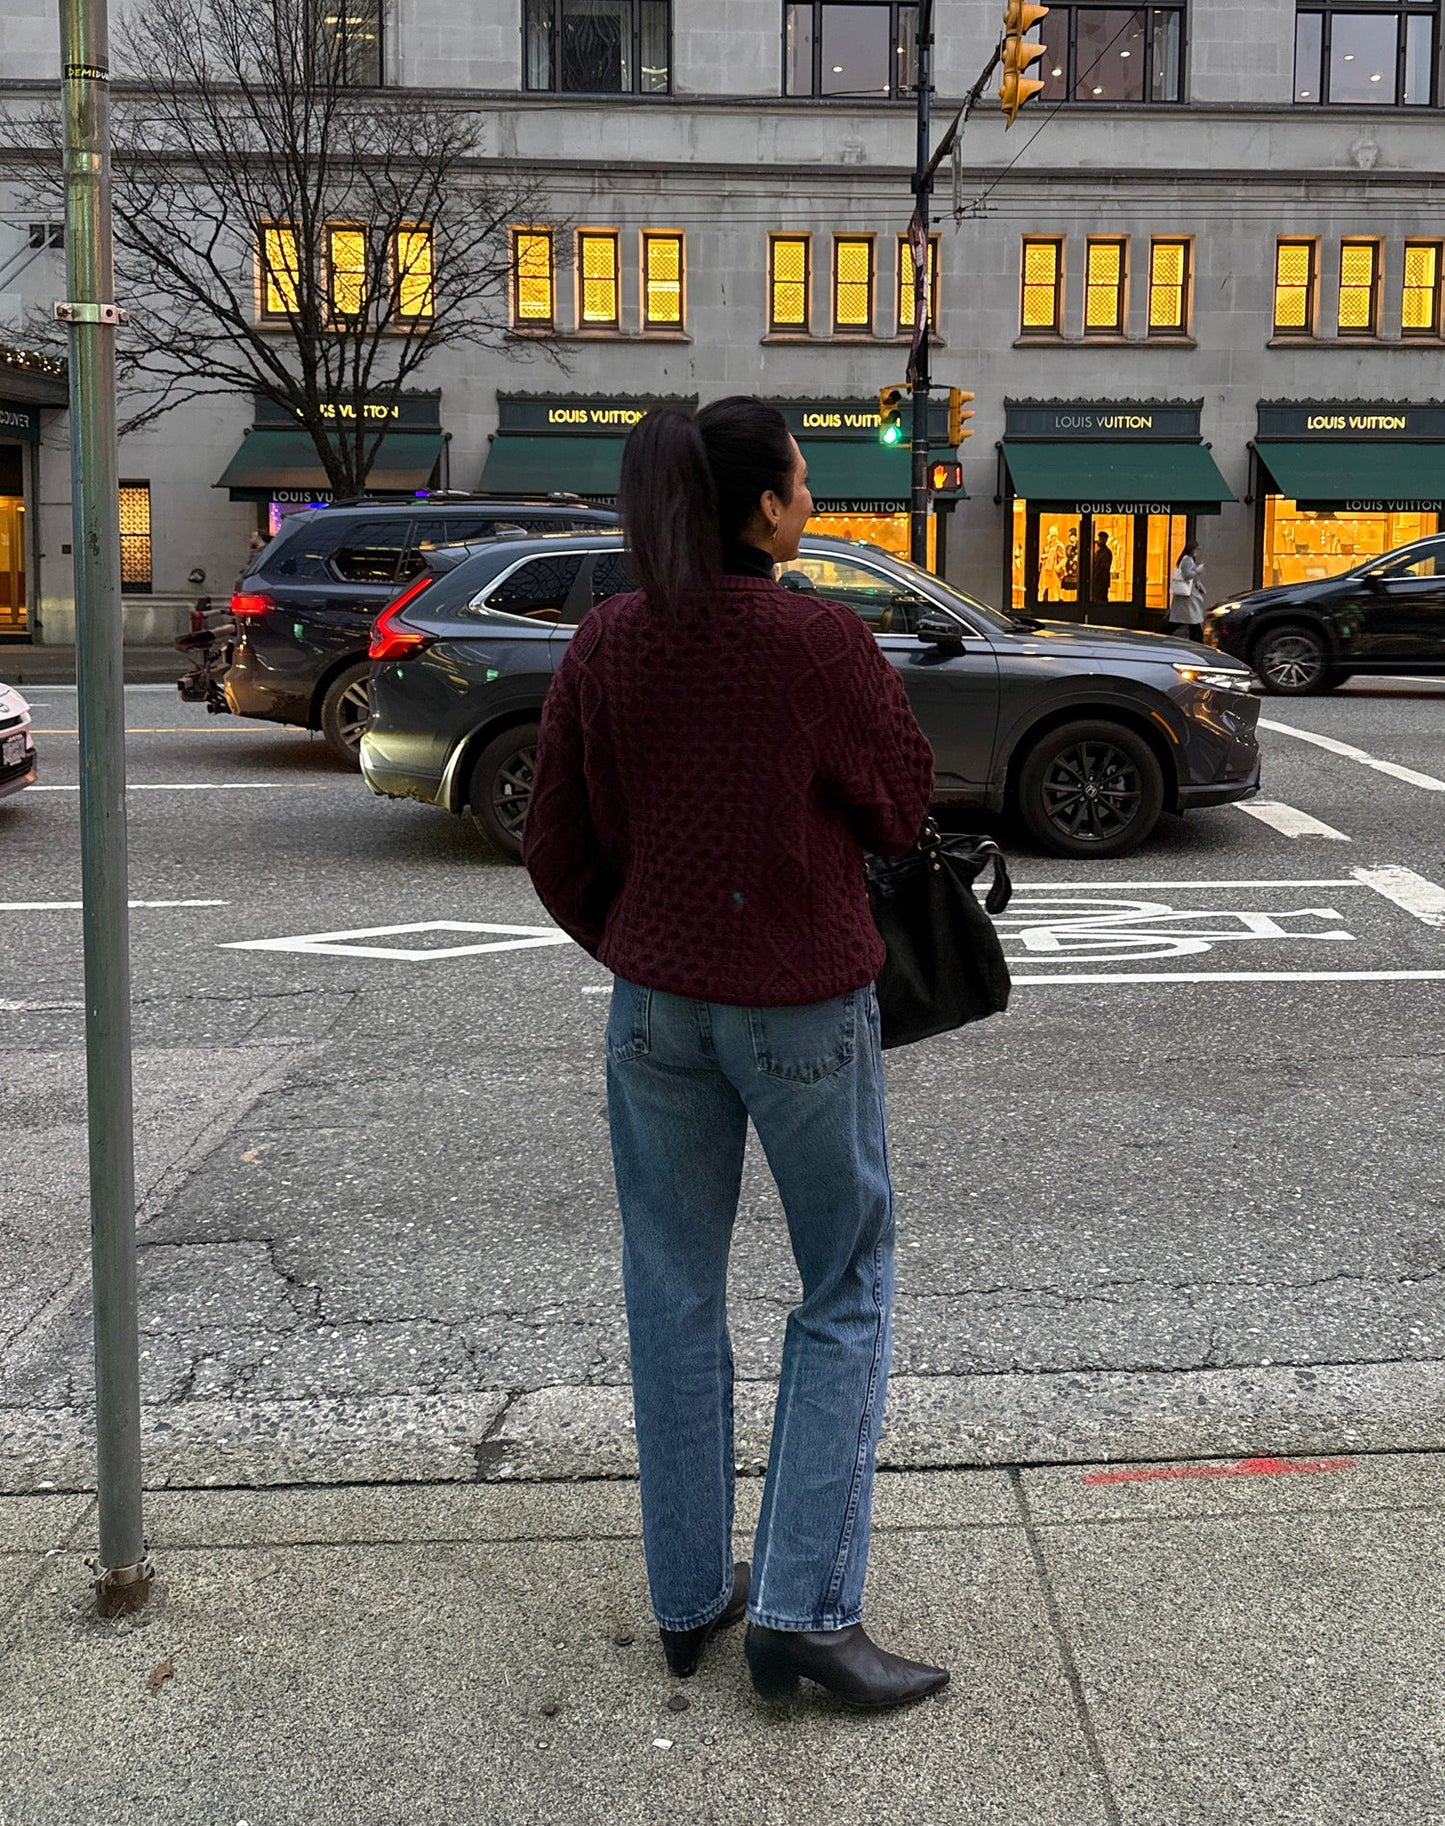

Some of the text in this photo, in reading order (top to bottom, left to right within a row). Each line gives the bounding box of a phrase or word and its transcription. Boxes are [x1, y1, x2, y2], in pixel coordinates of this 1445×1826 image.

[548, 409, 588, 423] LOUIS
[803, 413, 842, 427] LOUIS
[1055, 416, 1152, 428] LOUIS VUITTON
[1307, 416, 1406, 430] LOUIS VUITTON
[272, 491, 311, 502] LOUIS
[851, 501, 906, 512] VUITTON
[1075, 503, 1171, 514] LOUIS VUITTON
[1346, 500, 1442, 511] LOUIS VUITTON
